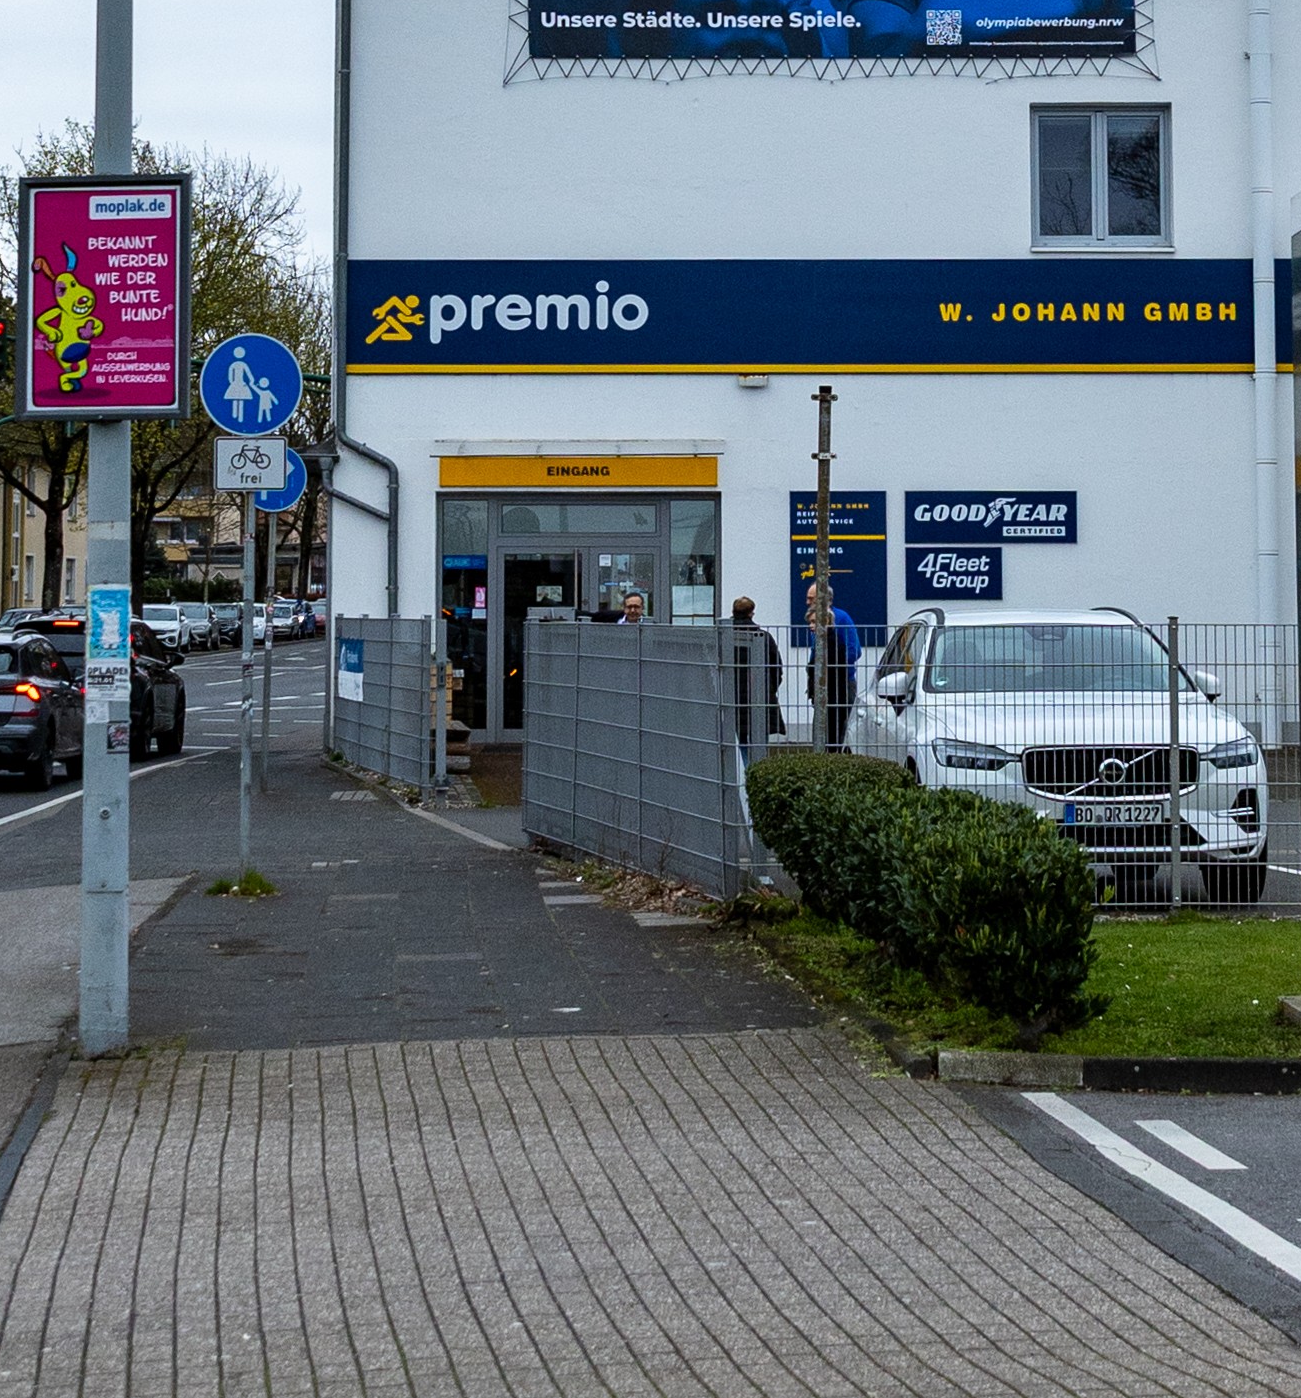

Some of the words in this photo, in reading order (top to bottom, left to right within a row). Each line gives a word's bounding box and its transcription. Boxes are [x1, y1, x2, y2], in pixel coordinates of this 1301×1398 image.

[540, 12, 617, 28] Unsere
[622, 10, 701, 28] Städte.
[707, 12, 784, 28] Unsere
[789, 10, 862, 31] Spiele.
[975, 16, 1125, 29] olympiabewerbung.nrw
[95, 198, 166, 216] moplak.de
[88, 235, 158, 250] BEKANNT
[108, 253, 168, 267] WERDEN
[95, 272, 121, 285] WIE
[126, 271, 156, 285] DER
[109, 289, 161, 304] BUNTE
[121, 306, 168, 322] HUND!
[429, 280, 649, 344] premio
[939, 303, 973, 321] W.
[991, 302, 1125, 322] JOHANN
[1144, 302, 1237, 322] GMBH
[240, 472, 262, 484] frei
[546, 466, 611, 476] EINGANG
[1005, 527, 1064, 536] CERTIFIED
[917, 552, 990, 578] 4Fleet
[932, 573, 989, 594] Group
[1124, 806, 1160, 823] 1227
